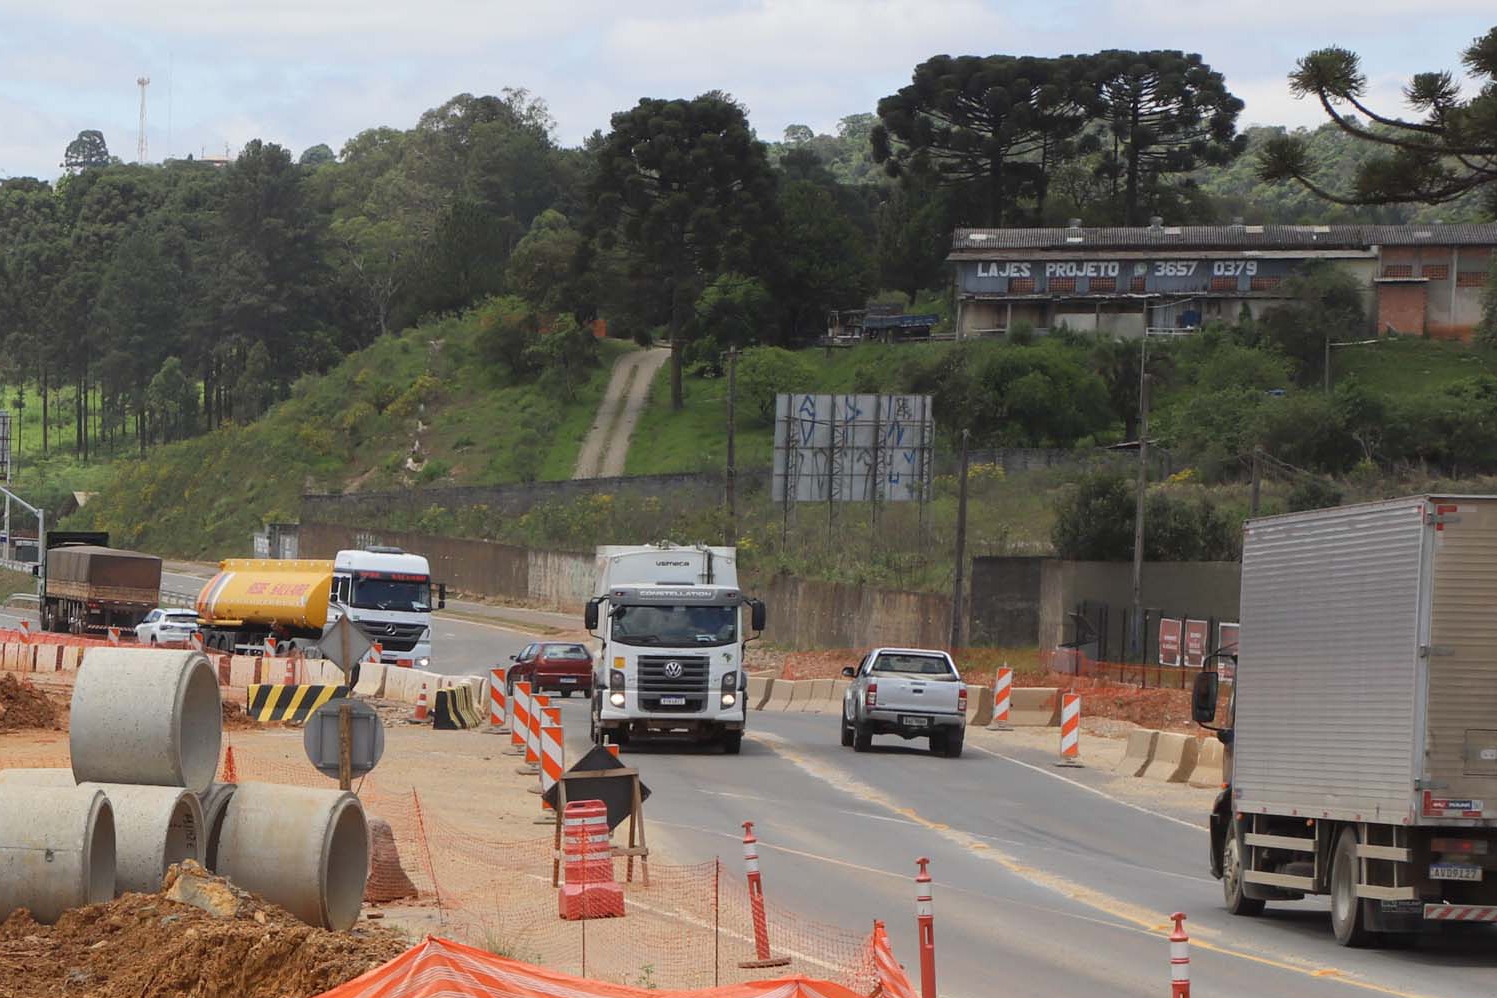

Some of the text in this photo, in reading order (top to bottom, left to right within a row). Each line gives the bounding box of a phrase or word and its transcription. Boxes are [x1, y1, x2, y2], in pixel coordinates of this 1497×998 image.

[977, 261, 1258, 277] LAJES PROJETO 3657 0379
